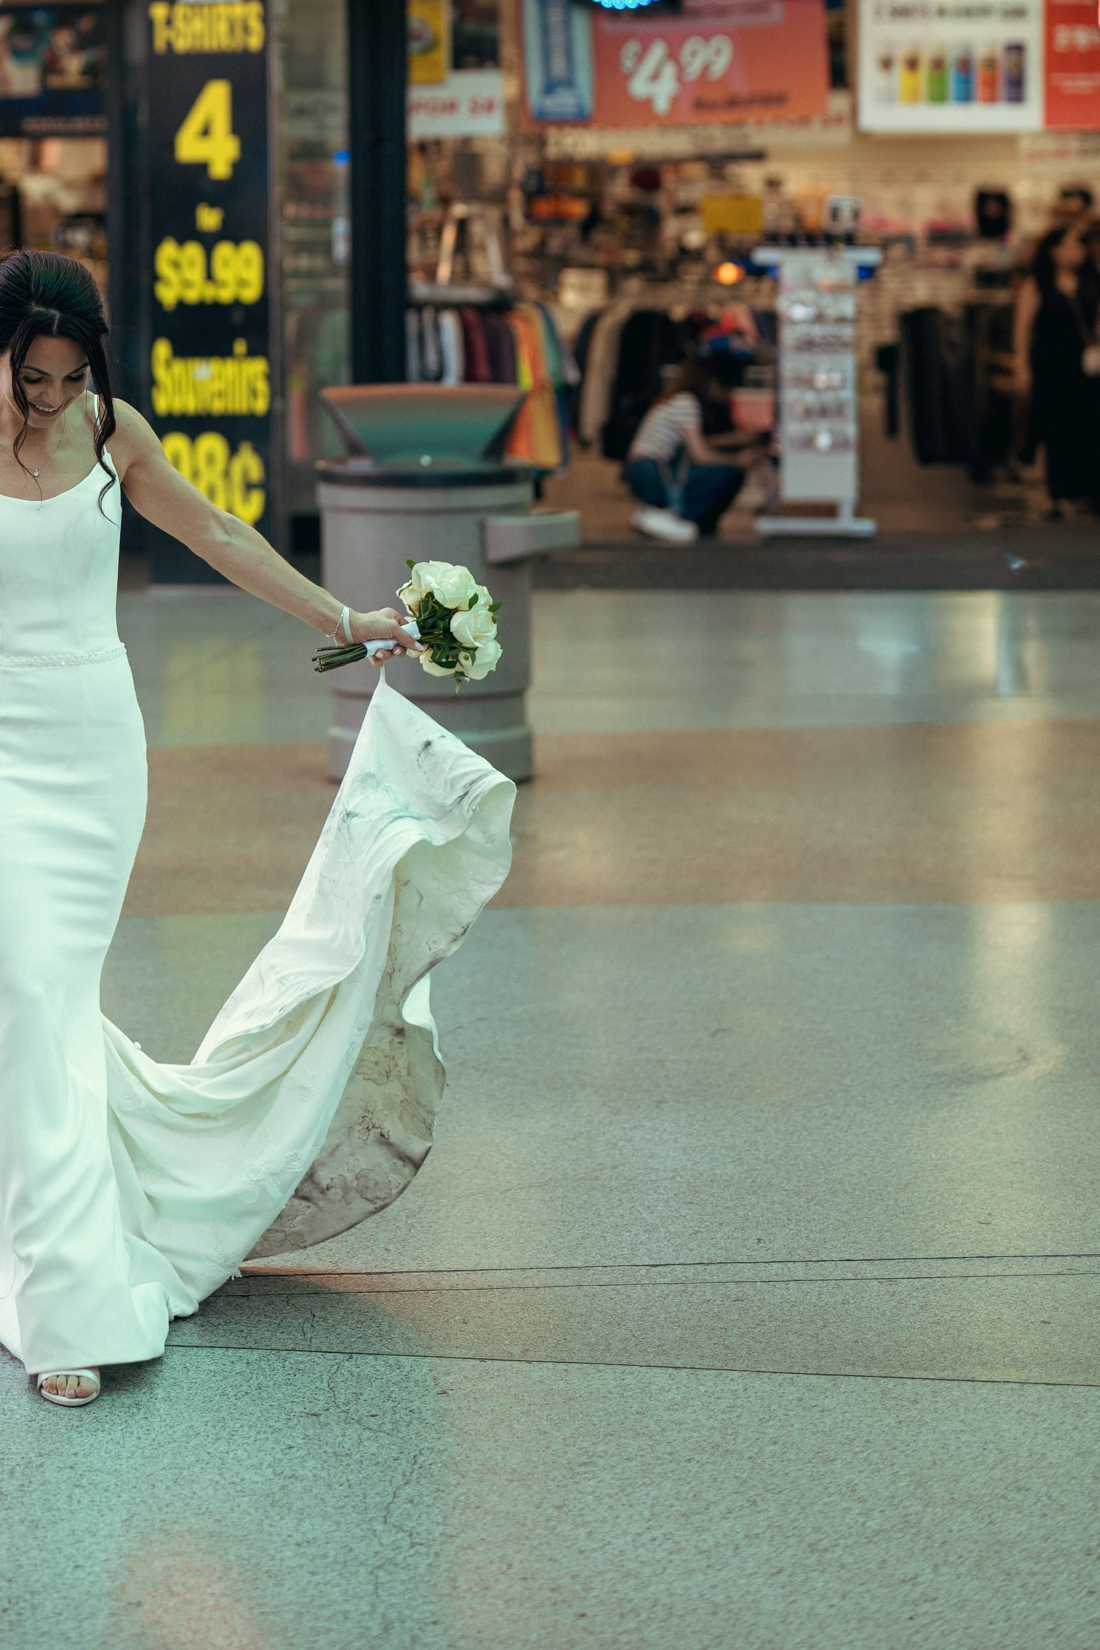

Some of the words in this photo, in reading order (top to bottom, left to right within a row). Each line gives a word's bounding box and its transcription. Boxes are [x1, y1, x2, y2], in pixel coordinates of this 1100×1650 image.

[174, 78, 241, 181] 4
[154, 236, 265, 311] $9.99
[151, 336, 270, 417] Souvenirs
